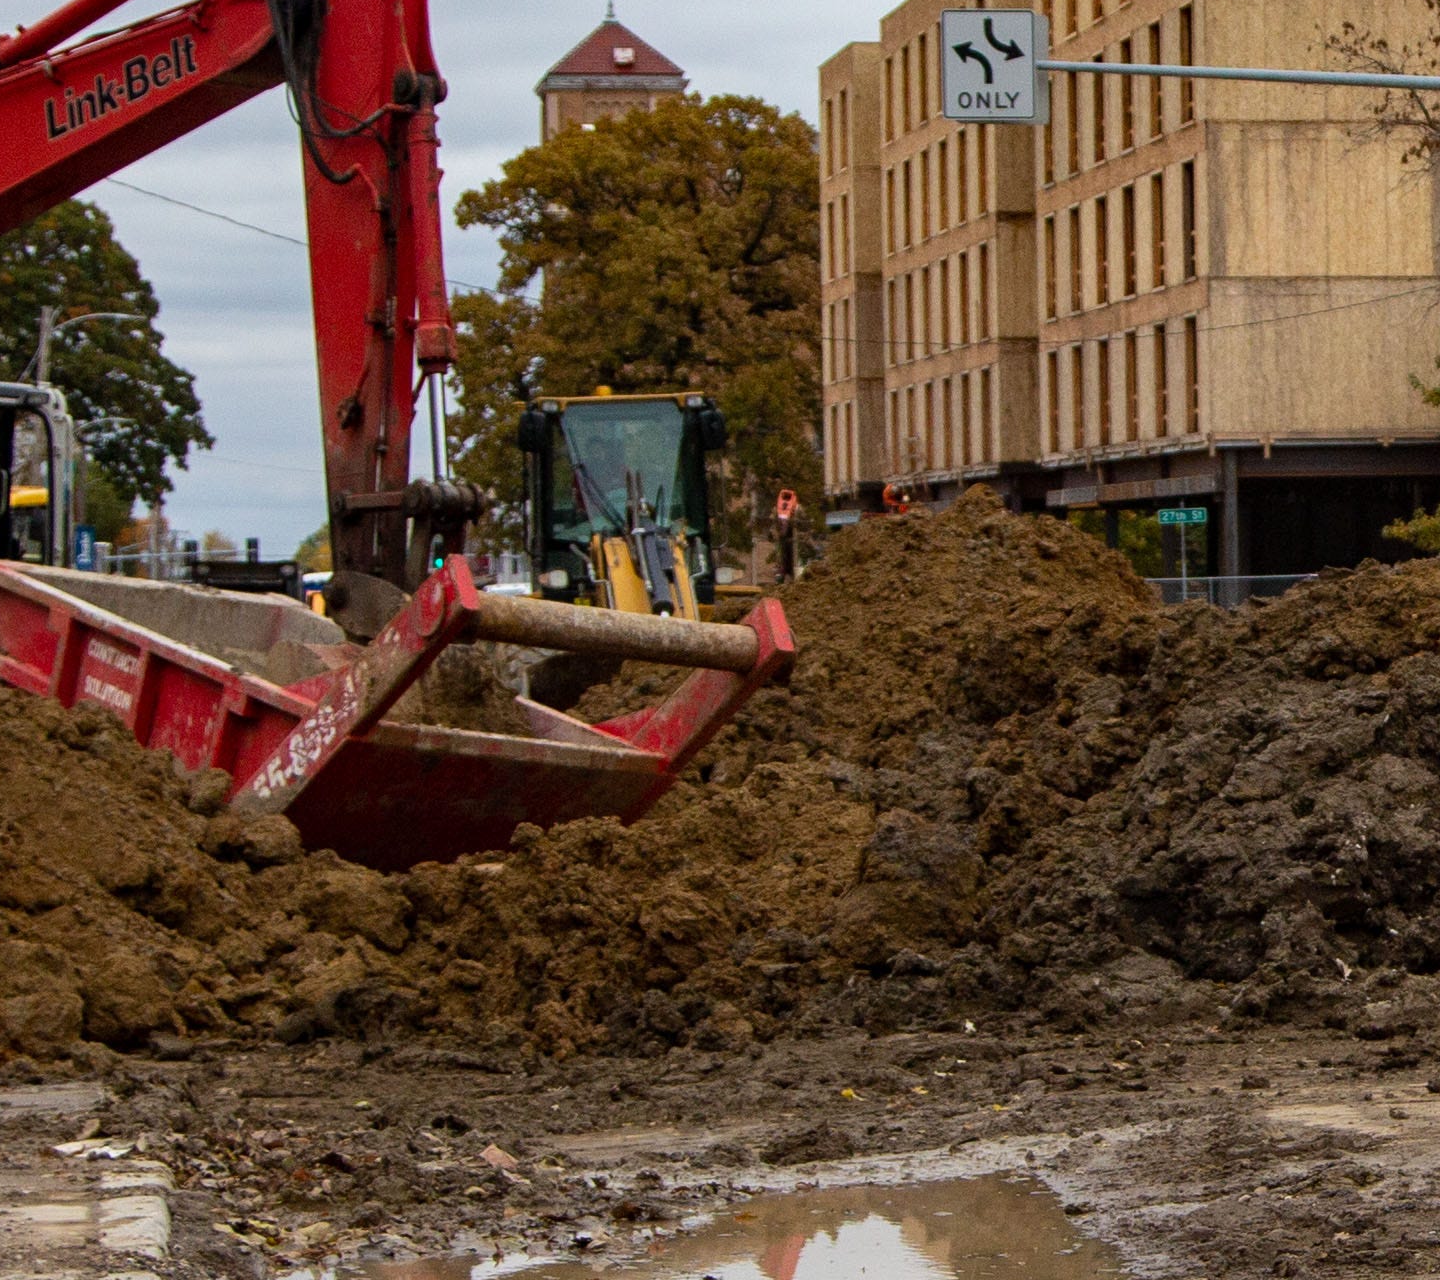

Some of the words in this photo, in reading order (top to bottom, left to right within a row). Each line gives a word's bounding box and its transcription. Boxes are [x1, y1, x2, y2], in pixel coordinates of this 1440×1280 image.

[45, 35, 197, 141] Link-Belt
[957, 91, 1020, 109] ONLY
[1161, 511, 1187, 521] 27th
